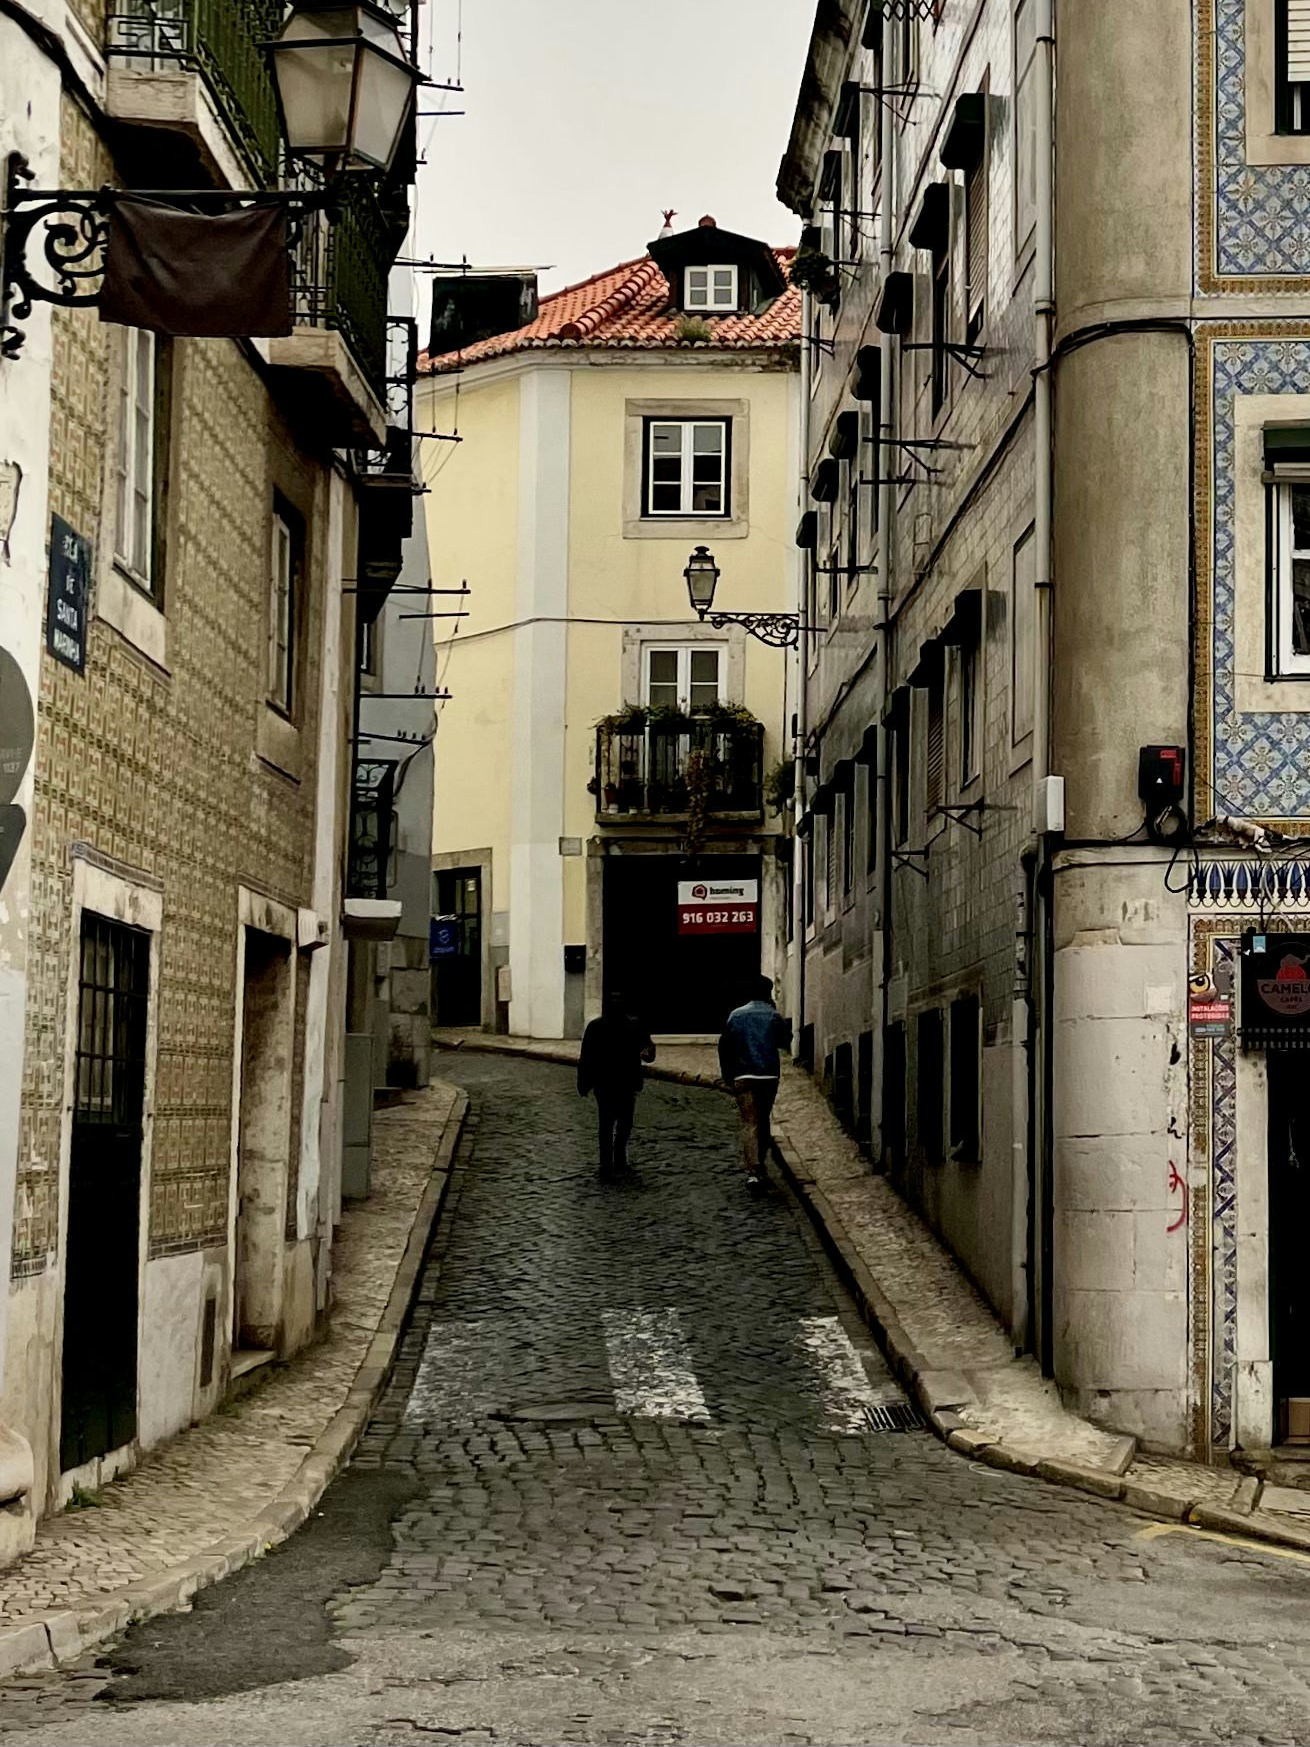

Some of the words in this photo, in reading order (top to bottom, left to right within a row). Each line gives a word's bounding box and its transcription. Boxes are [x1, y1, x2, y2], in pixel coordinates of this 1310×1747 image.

[56, 598, 78, 632] SANTA
[709, 886, 744, 896] homing
[682, 912, 704, 924] 916
[706, 911, 729, 923] 032
[731, 910, 754, 923] 263
